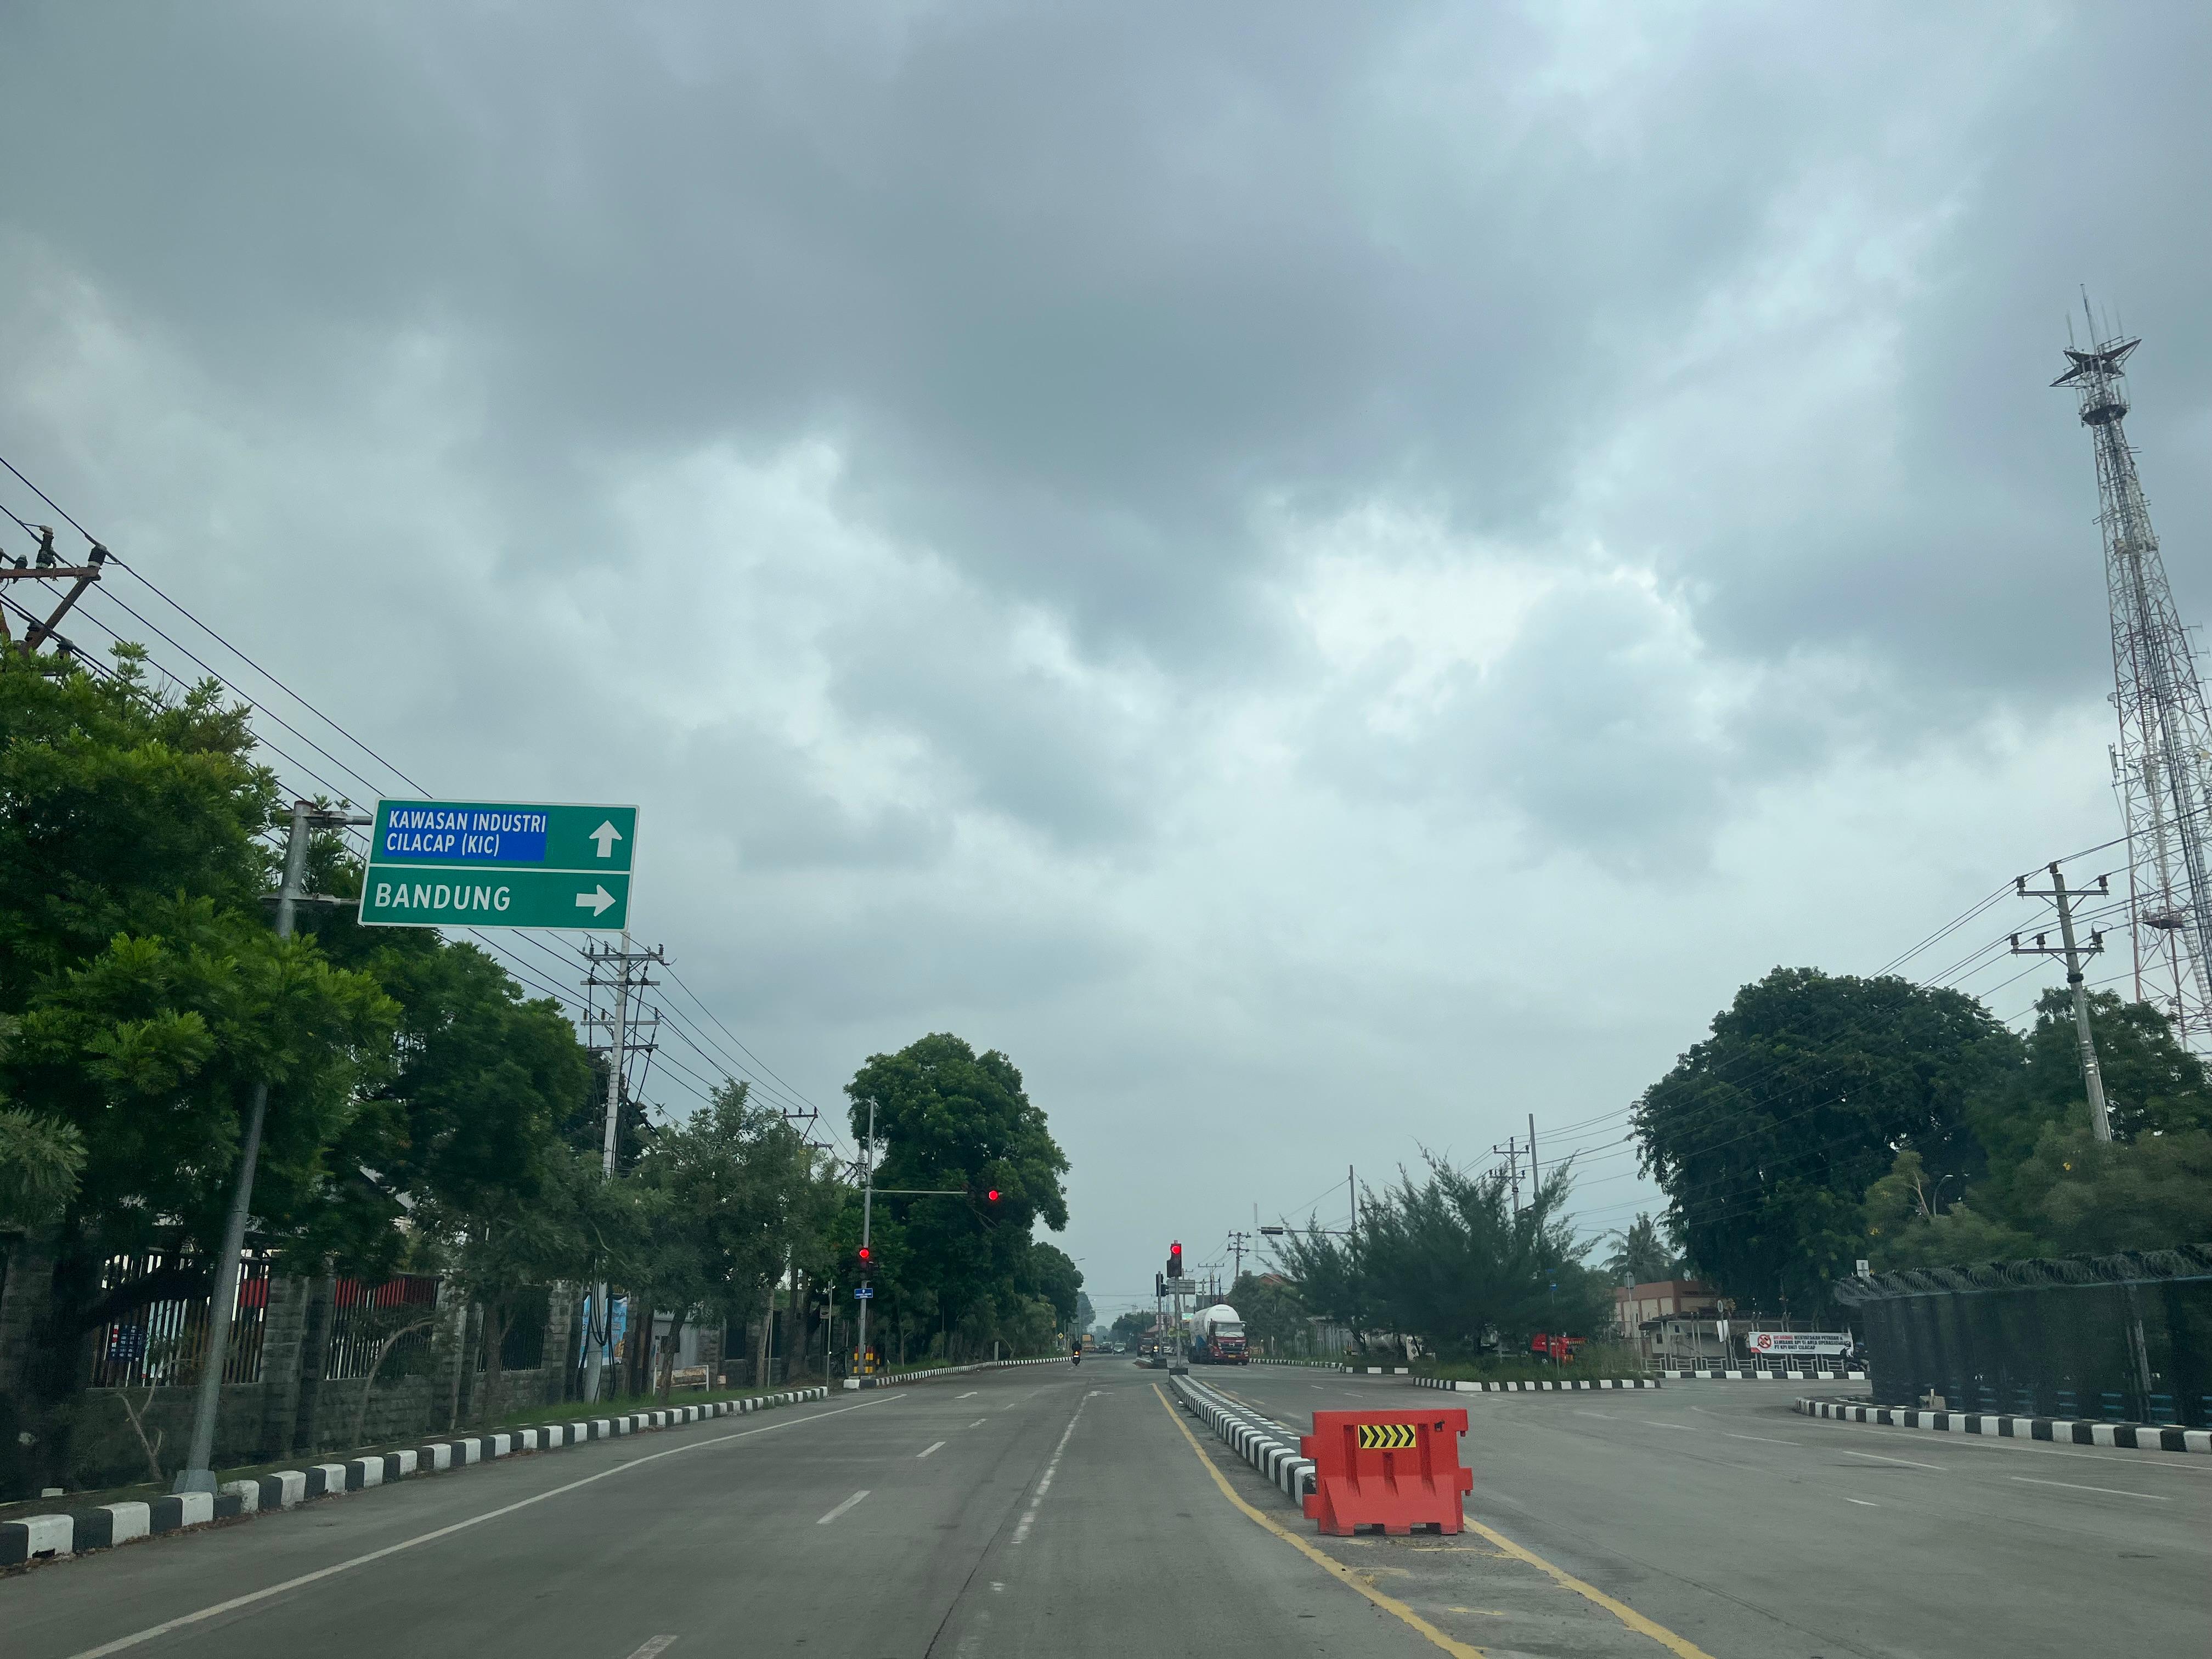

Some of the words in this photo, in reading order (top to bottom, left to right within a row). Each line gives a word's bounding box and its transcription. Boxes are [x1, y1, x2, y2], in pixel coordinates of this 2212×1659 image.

[388, 810, 467, 830] KAWASAN
[473, 813, 546, 833] INDUSTRI
[387, 833, 455, 852] CILACAP
[462, 833, 500, 857] (KIC)
[375, 883, 511, 911] BANDUNG
